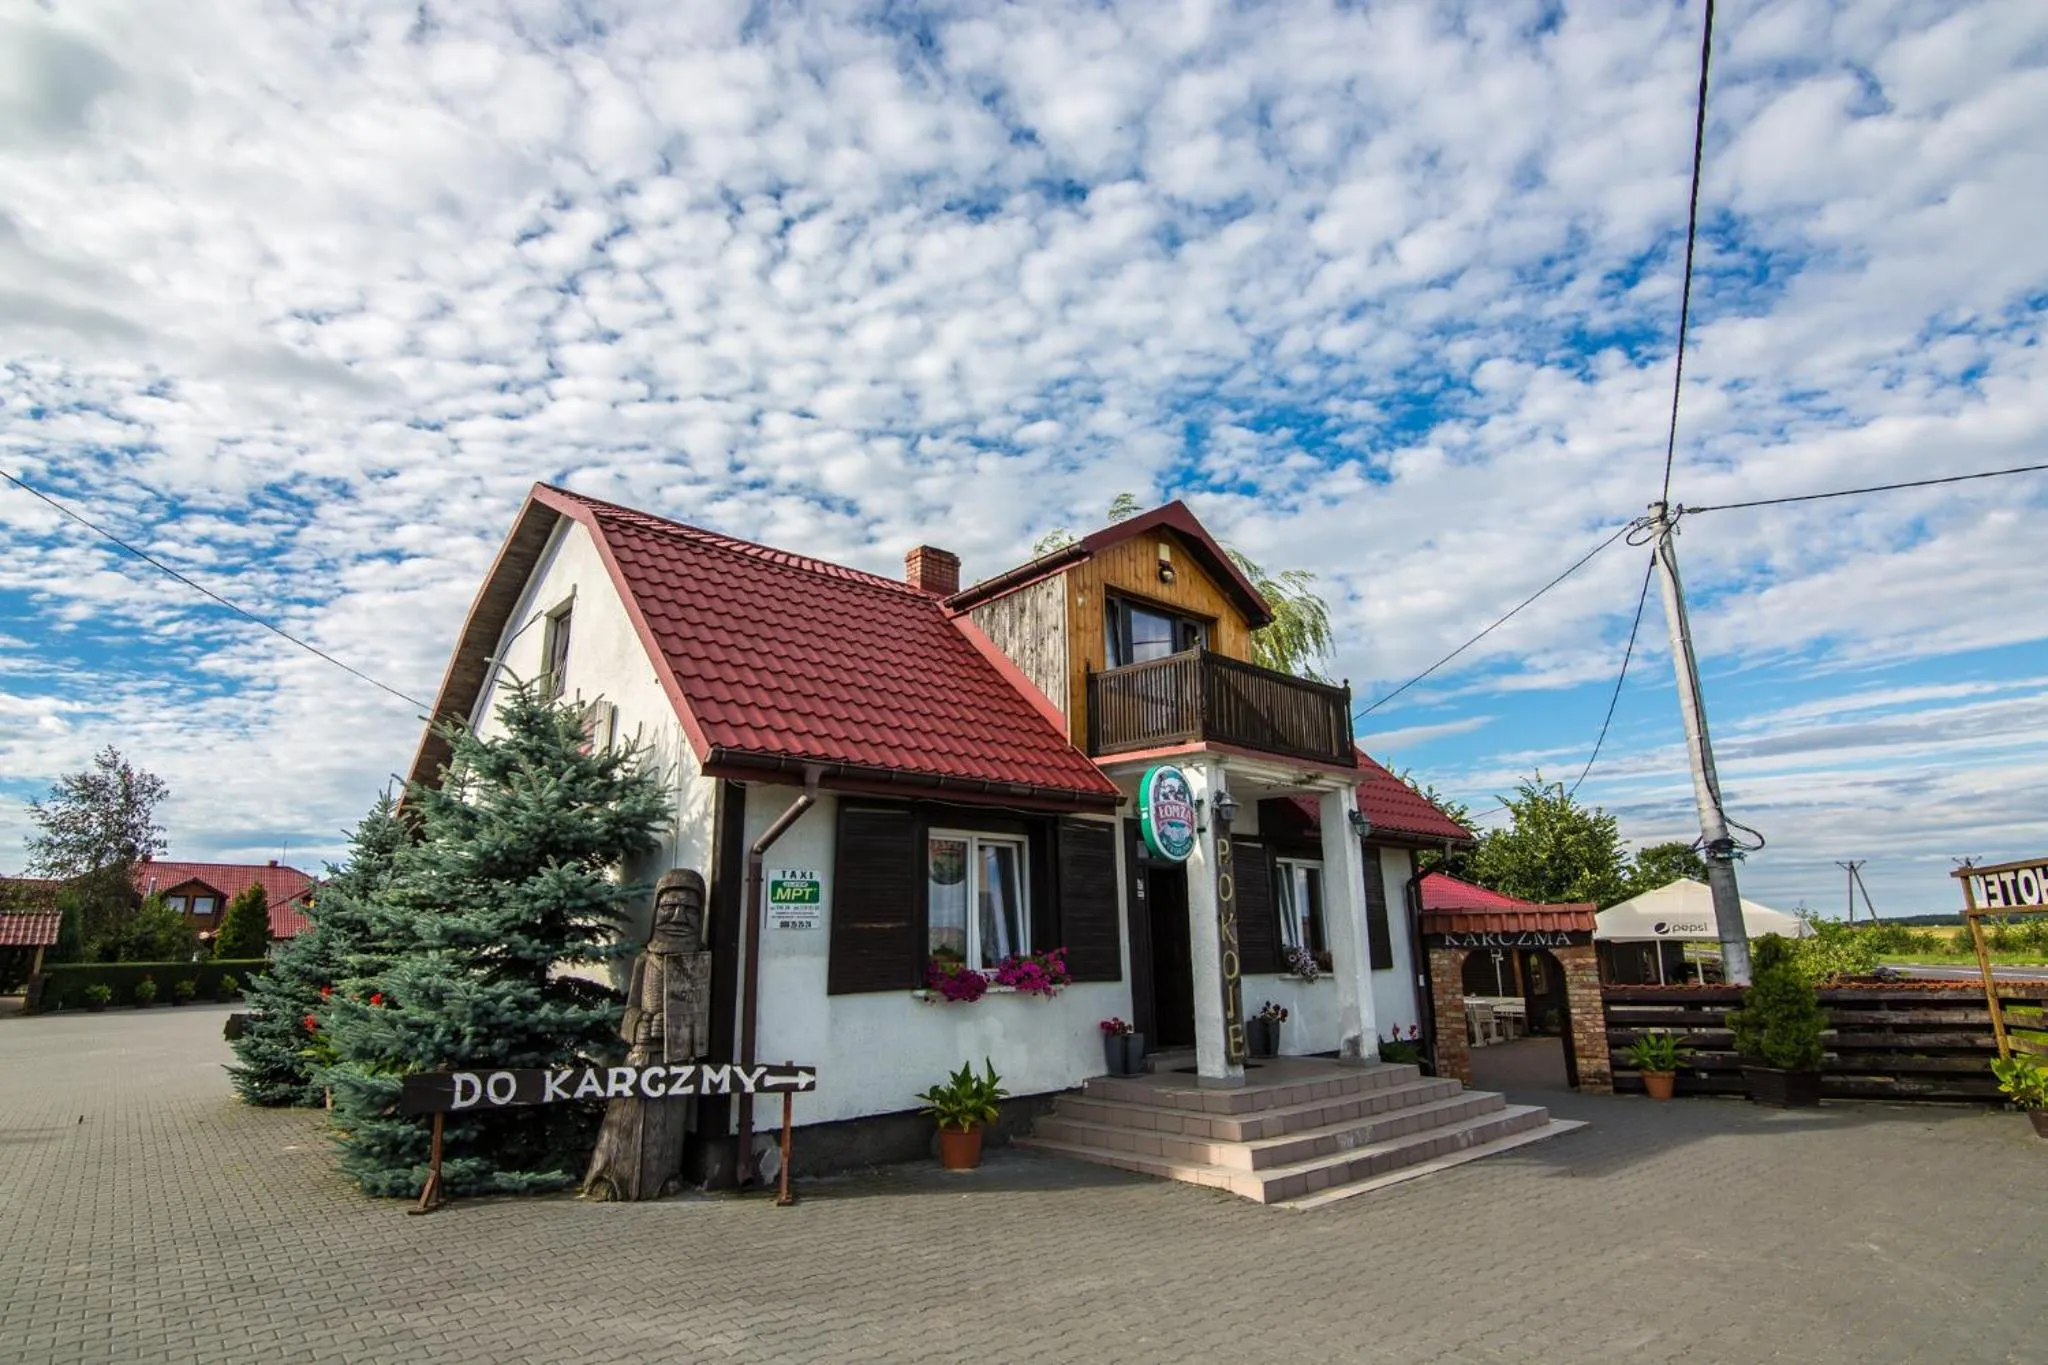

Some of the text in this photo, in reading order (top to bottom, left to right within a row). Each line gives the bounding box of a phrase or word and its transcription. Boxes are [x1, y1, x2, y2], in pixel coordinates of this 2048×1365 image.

[781, 870, 814, 880] TAXI
[1672, 922, 1708, 933] pepsi
[1444, 932, 1572, 946] KARCZMA
[1217, 838, 1244, 1057] POKOJE
[450, 1065, 768, 1110] DO KARCZMY
